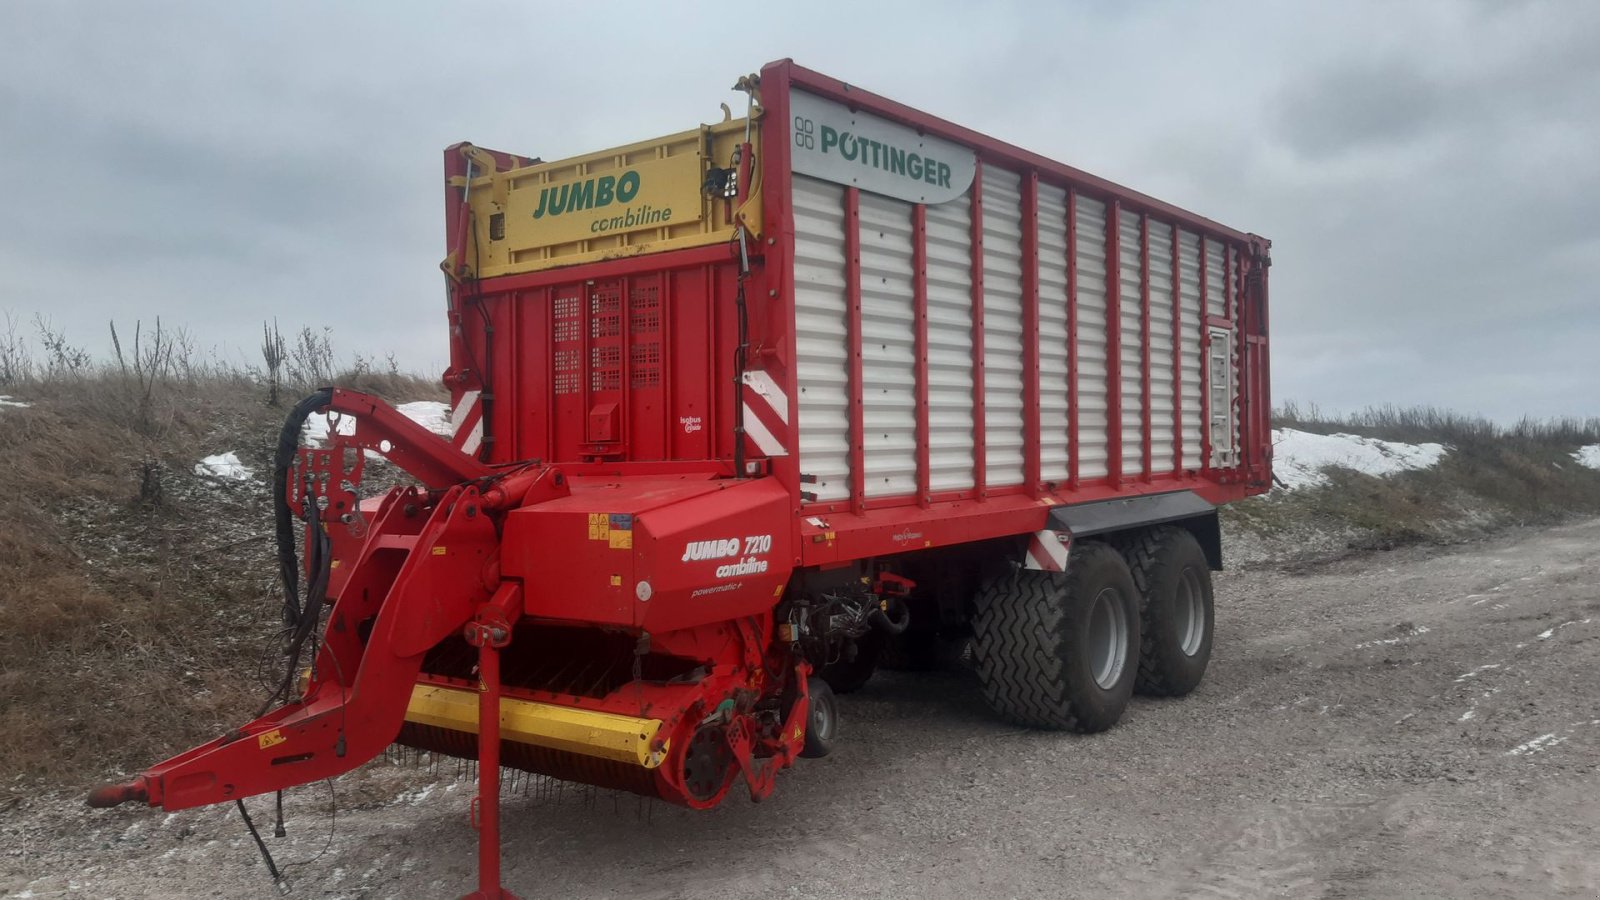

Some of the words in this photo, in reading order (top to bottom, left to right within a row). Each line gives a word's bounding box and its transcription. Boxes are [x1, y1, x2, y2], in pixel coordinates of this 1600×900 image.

[820, 125, 952, 189] PÖTTINGER
[532, 170, 641, 220] JUMBO
[590, 205, 672, 233] combiline
[681, 538, 740, 562] JUMBO
[743, 534, 772, 555] 7210
[716, 556, 768, 578] combiline
